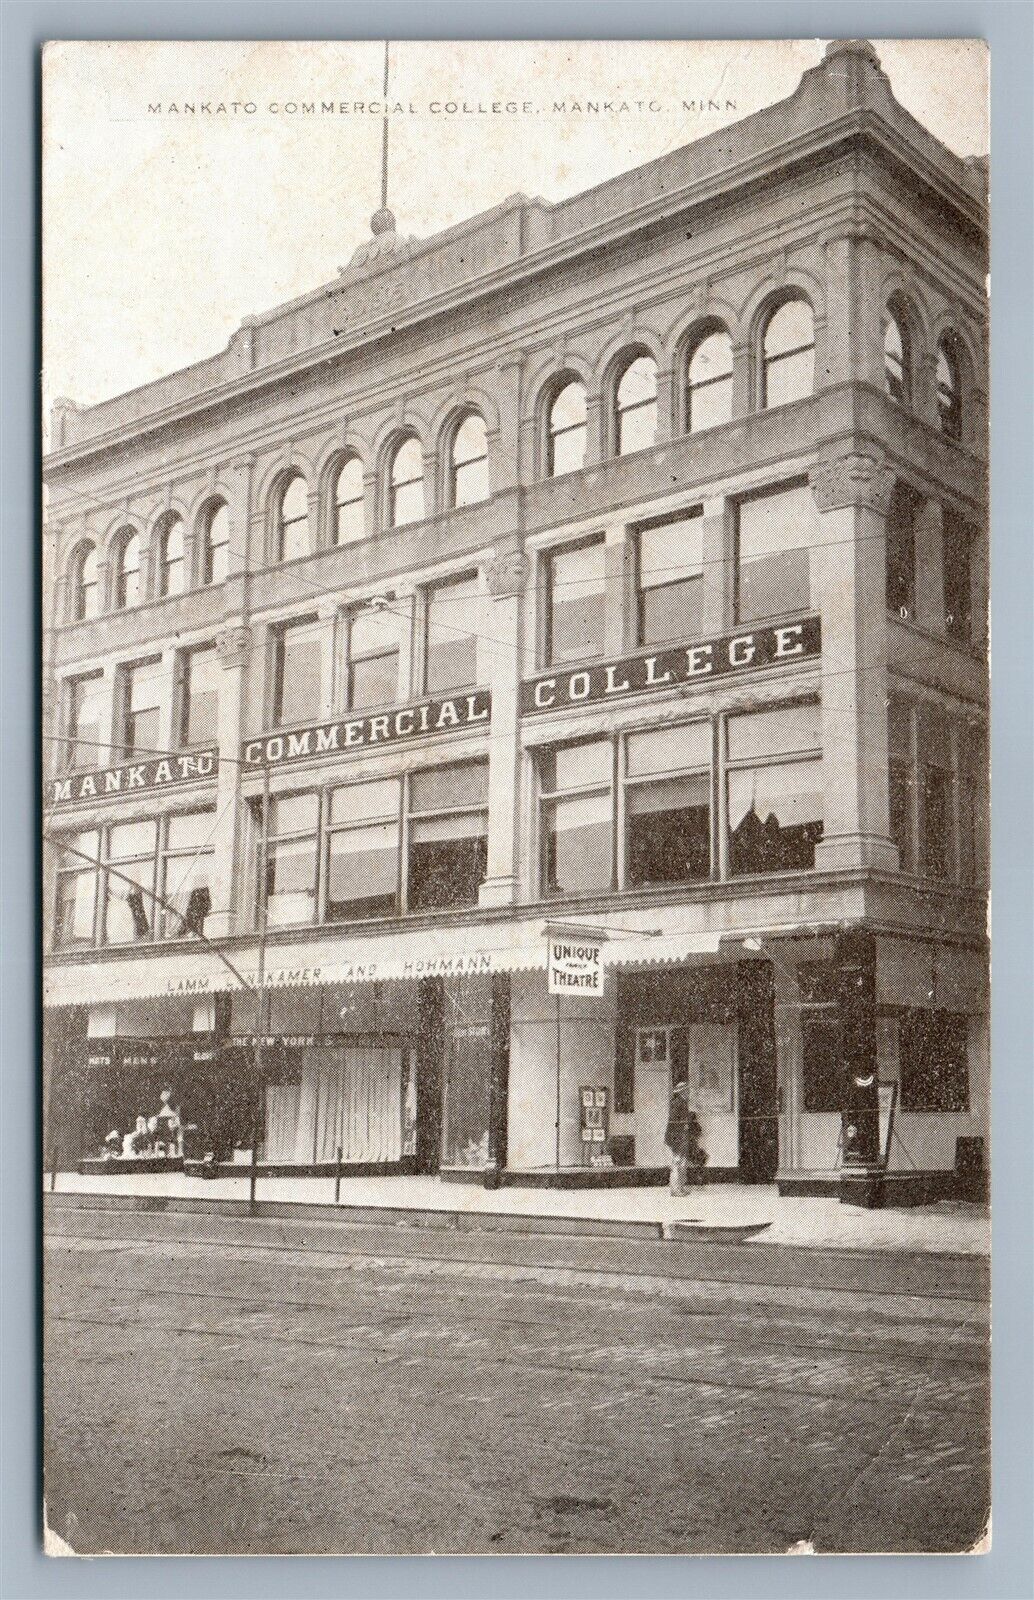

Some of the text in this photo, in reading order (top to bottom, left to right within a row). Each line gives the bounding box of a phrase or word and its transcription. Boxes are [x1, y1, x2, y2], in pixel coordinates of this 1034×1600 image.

[534, 624, 805, 708] COLLEGE
[244, 692, 490, 764] COMMERCIAL
[54, 755, 213, 801] MANKATO
[167, 978, 209, 992] LAMM
[347, 963, 377, 977] AND
[404, 955, 491, 972] HOHMANN
[554, 945, 600, 965] UNIQUE
[552, 967, 599, 988] THEATRE
[282, 1036, 314, 1046] YORK
